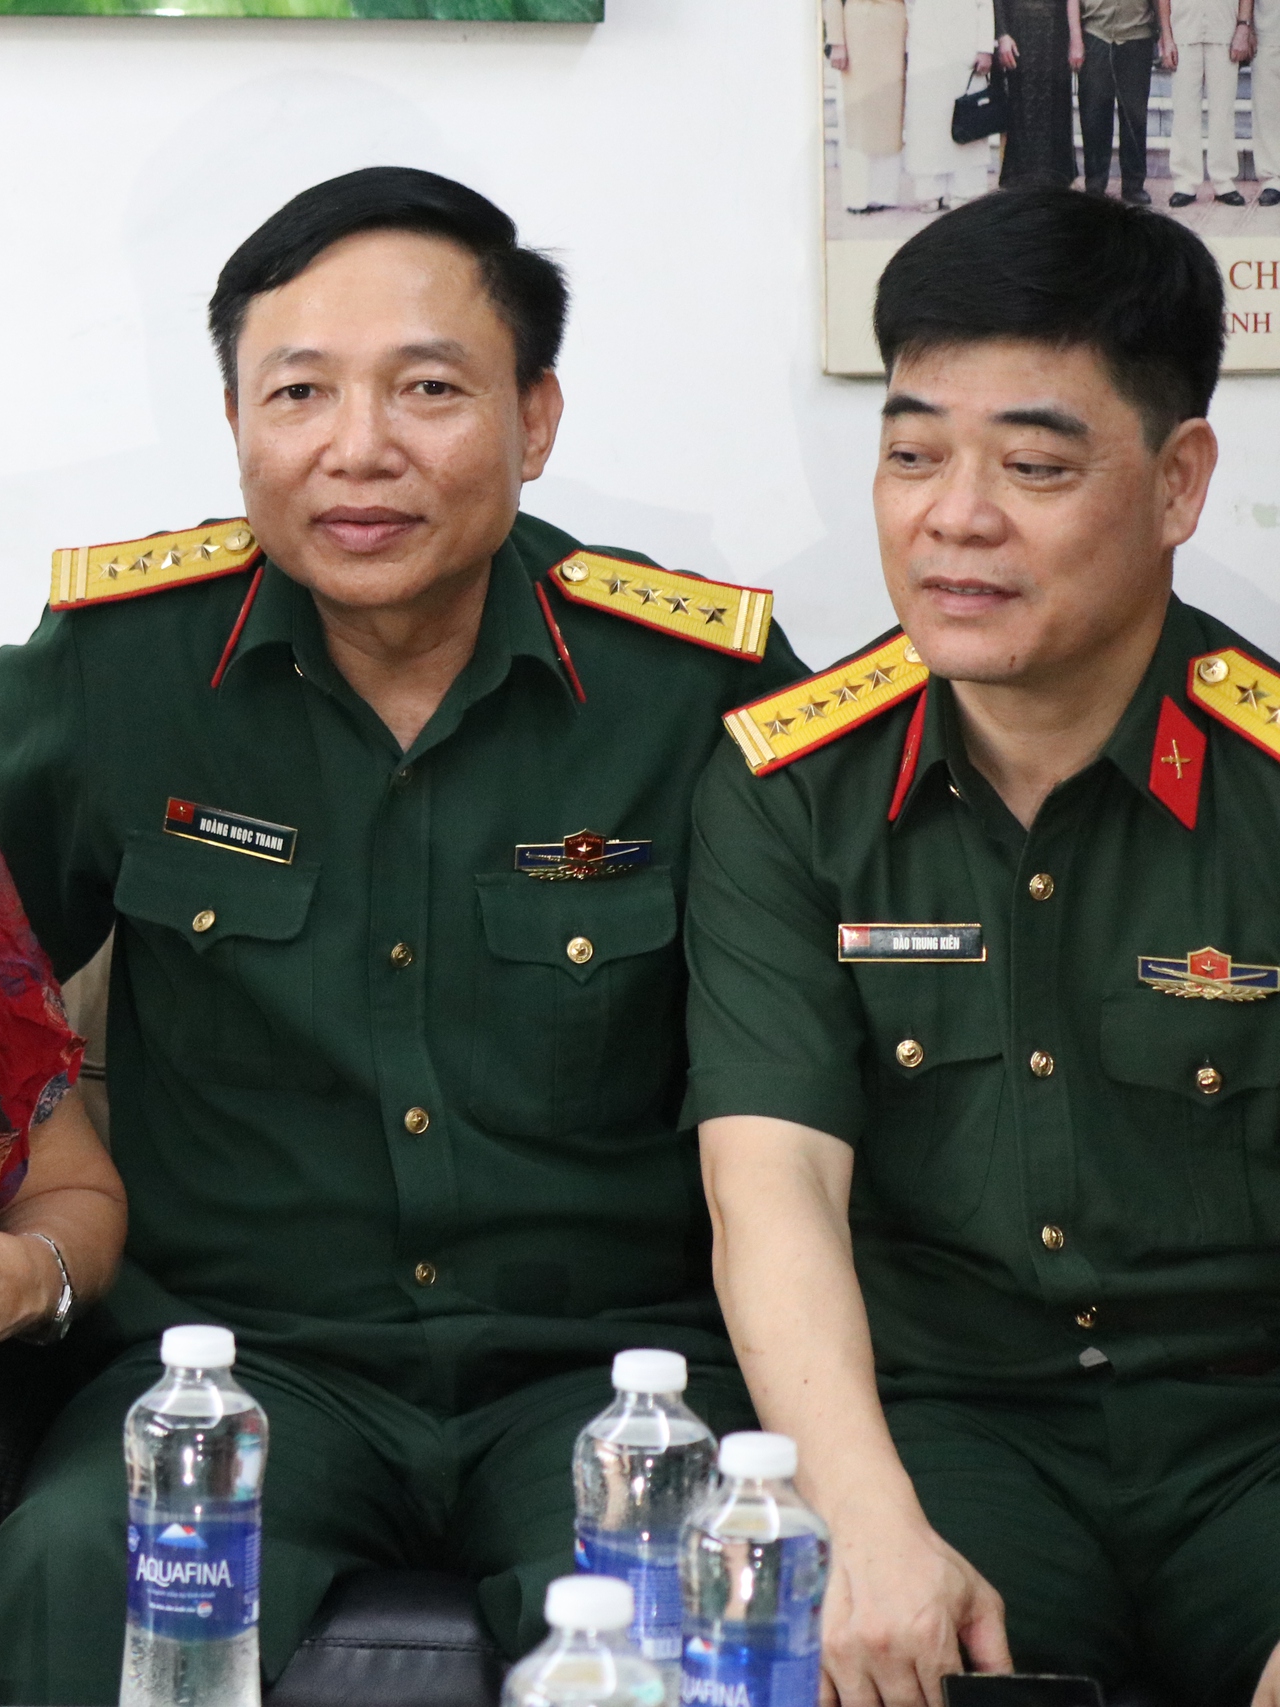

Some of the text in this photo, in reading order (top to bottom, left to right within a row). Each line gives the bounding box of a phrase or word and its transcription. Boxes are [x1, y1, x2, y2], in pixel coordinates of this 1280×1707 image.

[199, 818, 284, 851] HOÀNG NGỌC THANH
[893, 934, 960, 950] ĐÀO TRUNG KIÊN
[135, 1553, 232, 1588] AQUAFINA
